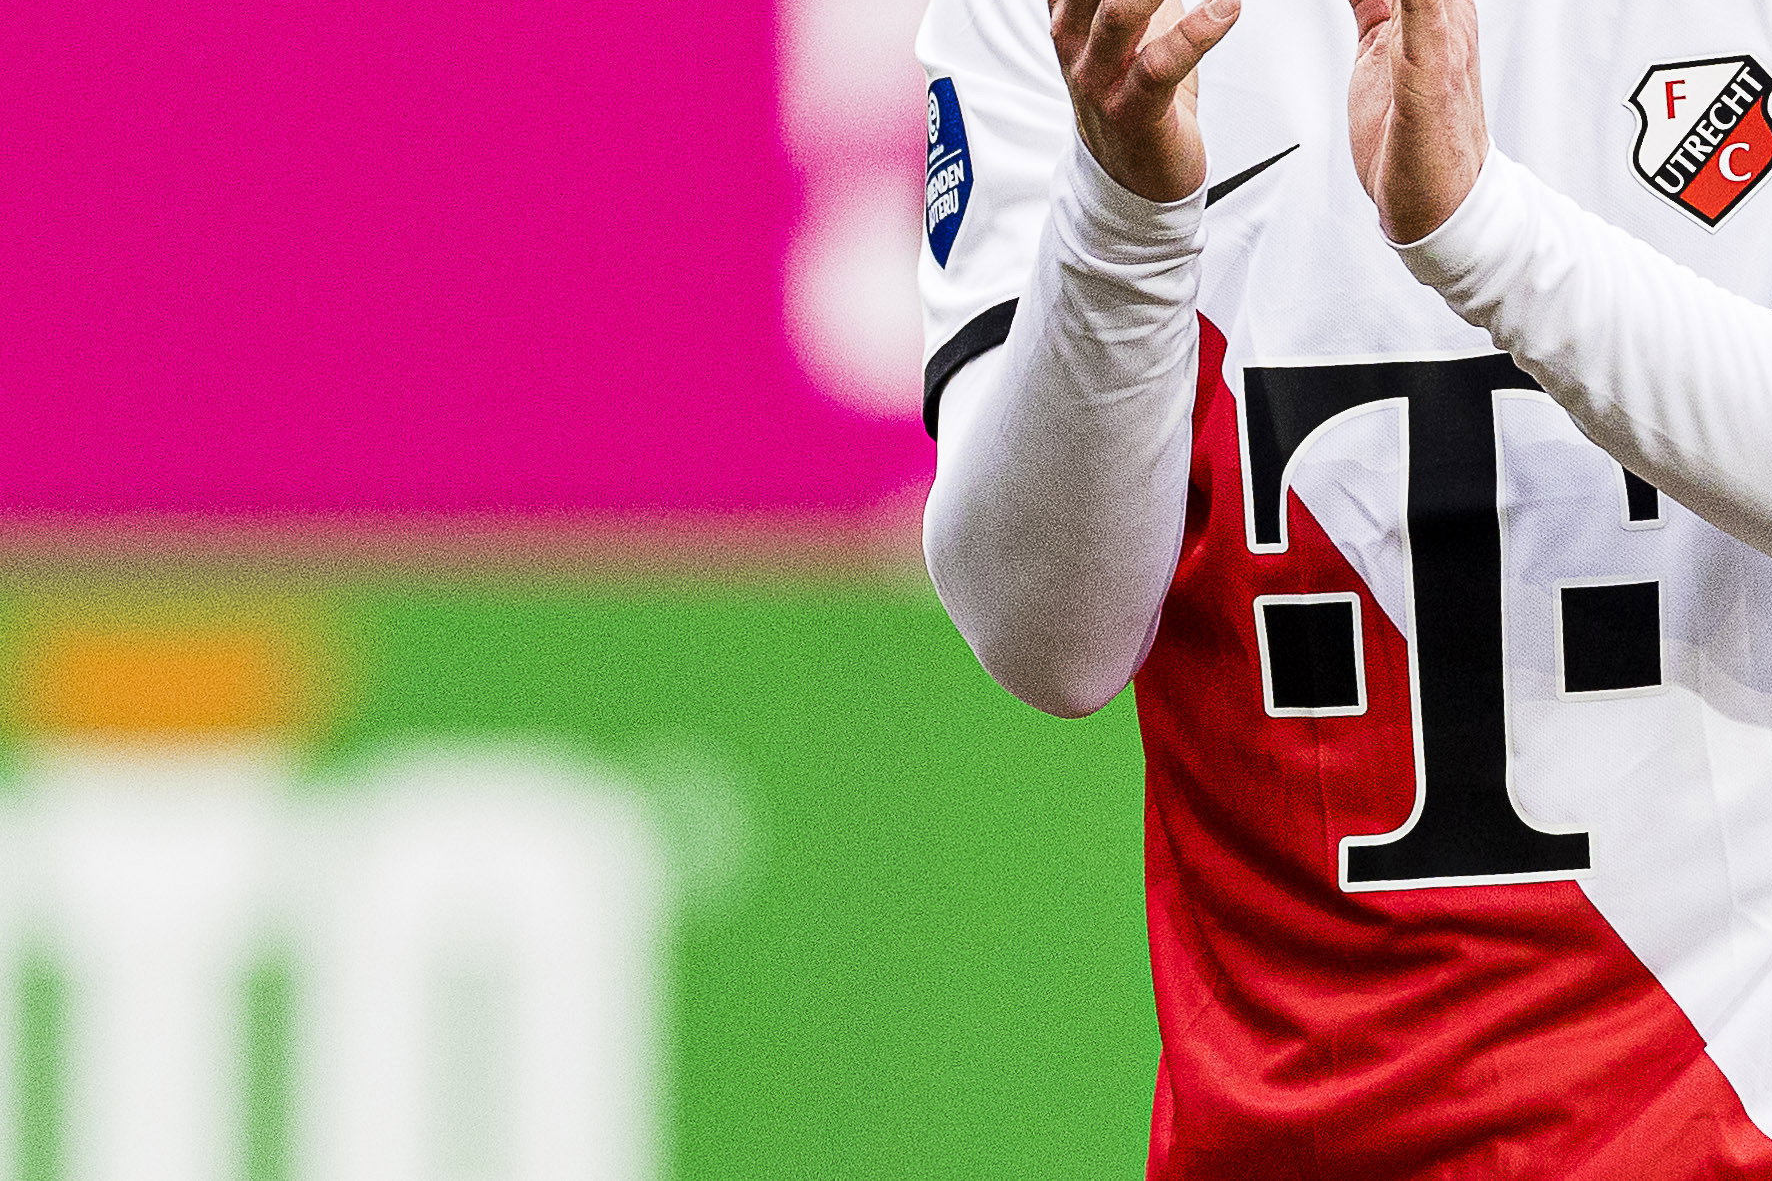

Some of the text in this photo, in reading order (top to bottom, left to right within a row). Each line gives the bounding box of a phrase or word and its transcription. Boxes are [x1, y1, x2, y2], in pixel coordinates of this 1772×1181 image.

[1664, 79, 1687, 120] F
[1654, 66, 1764, 194] UTRECHT
[1718, 142, 1752, 183] C
